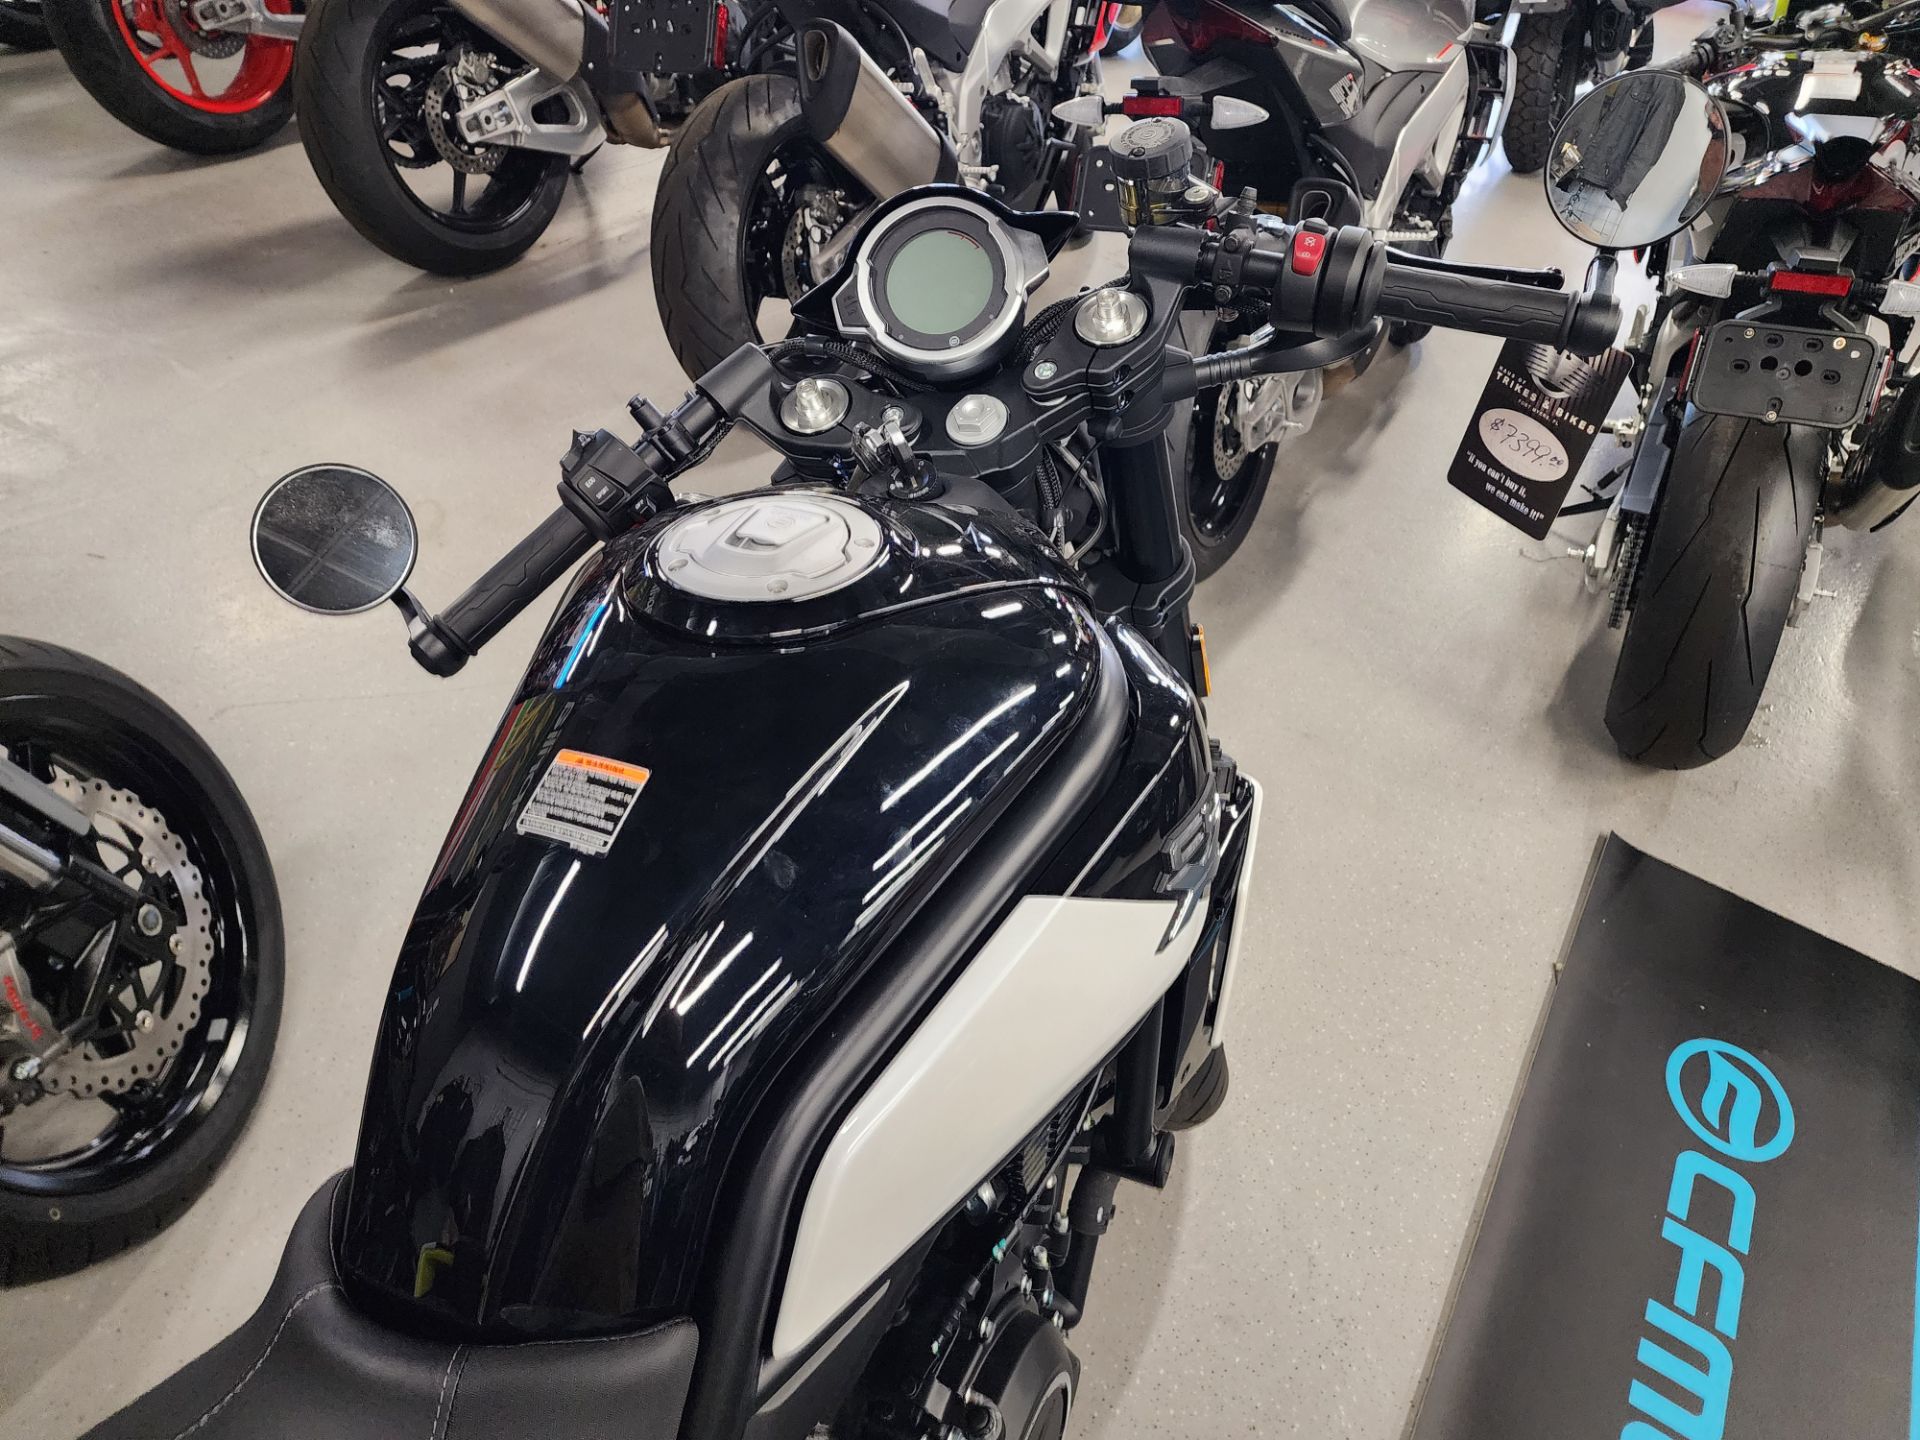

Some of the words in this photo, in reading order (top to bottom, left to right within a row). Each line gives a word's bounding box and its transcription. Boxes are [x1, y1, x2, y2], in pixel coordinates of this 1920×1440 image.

[1496, 371, 1538, 402] TRIKES
[1542, 399, 1550, 410] &
[1555, 407, 1595, 435] BIKES
[584, 476, 596, 489] ECO
[595, 485, 610, 500] SPORT
[1473, 458, 1488, 473] you
[1487, 466, 1507, 484] can't
[1505, 476, 1520, 493] buy
[1485, 482, 1496, 494] we
[1495, 488, 1510, 503] can
[1508, 497, 1530, 516] make
[1620, 1151, 1757, 1440] CFM
